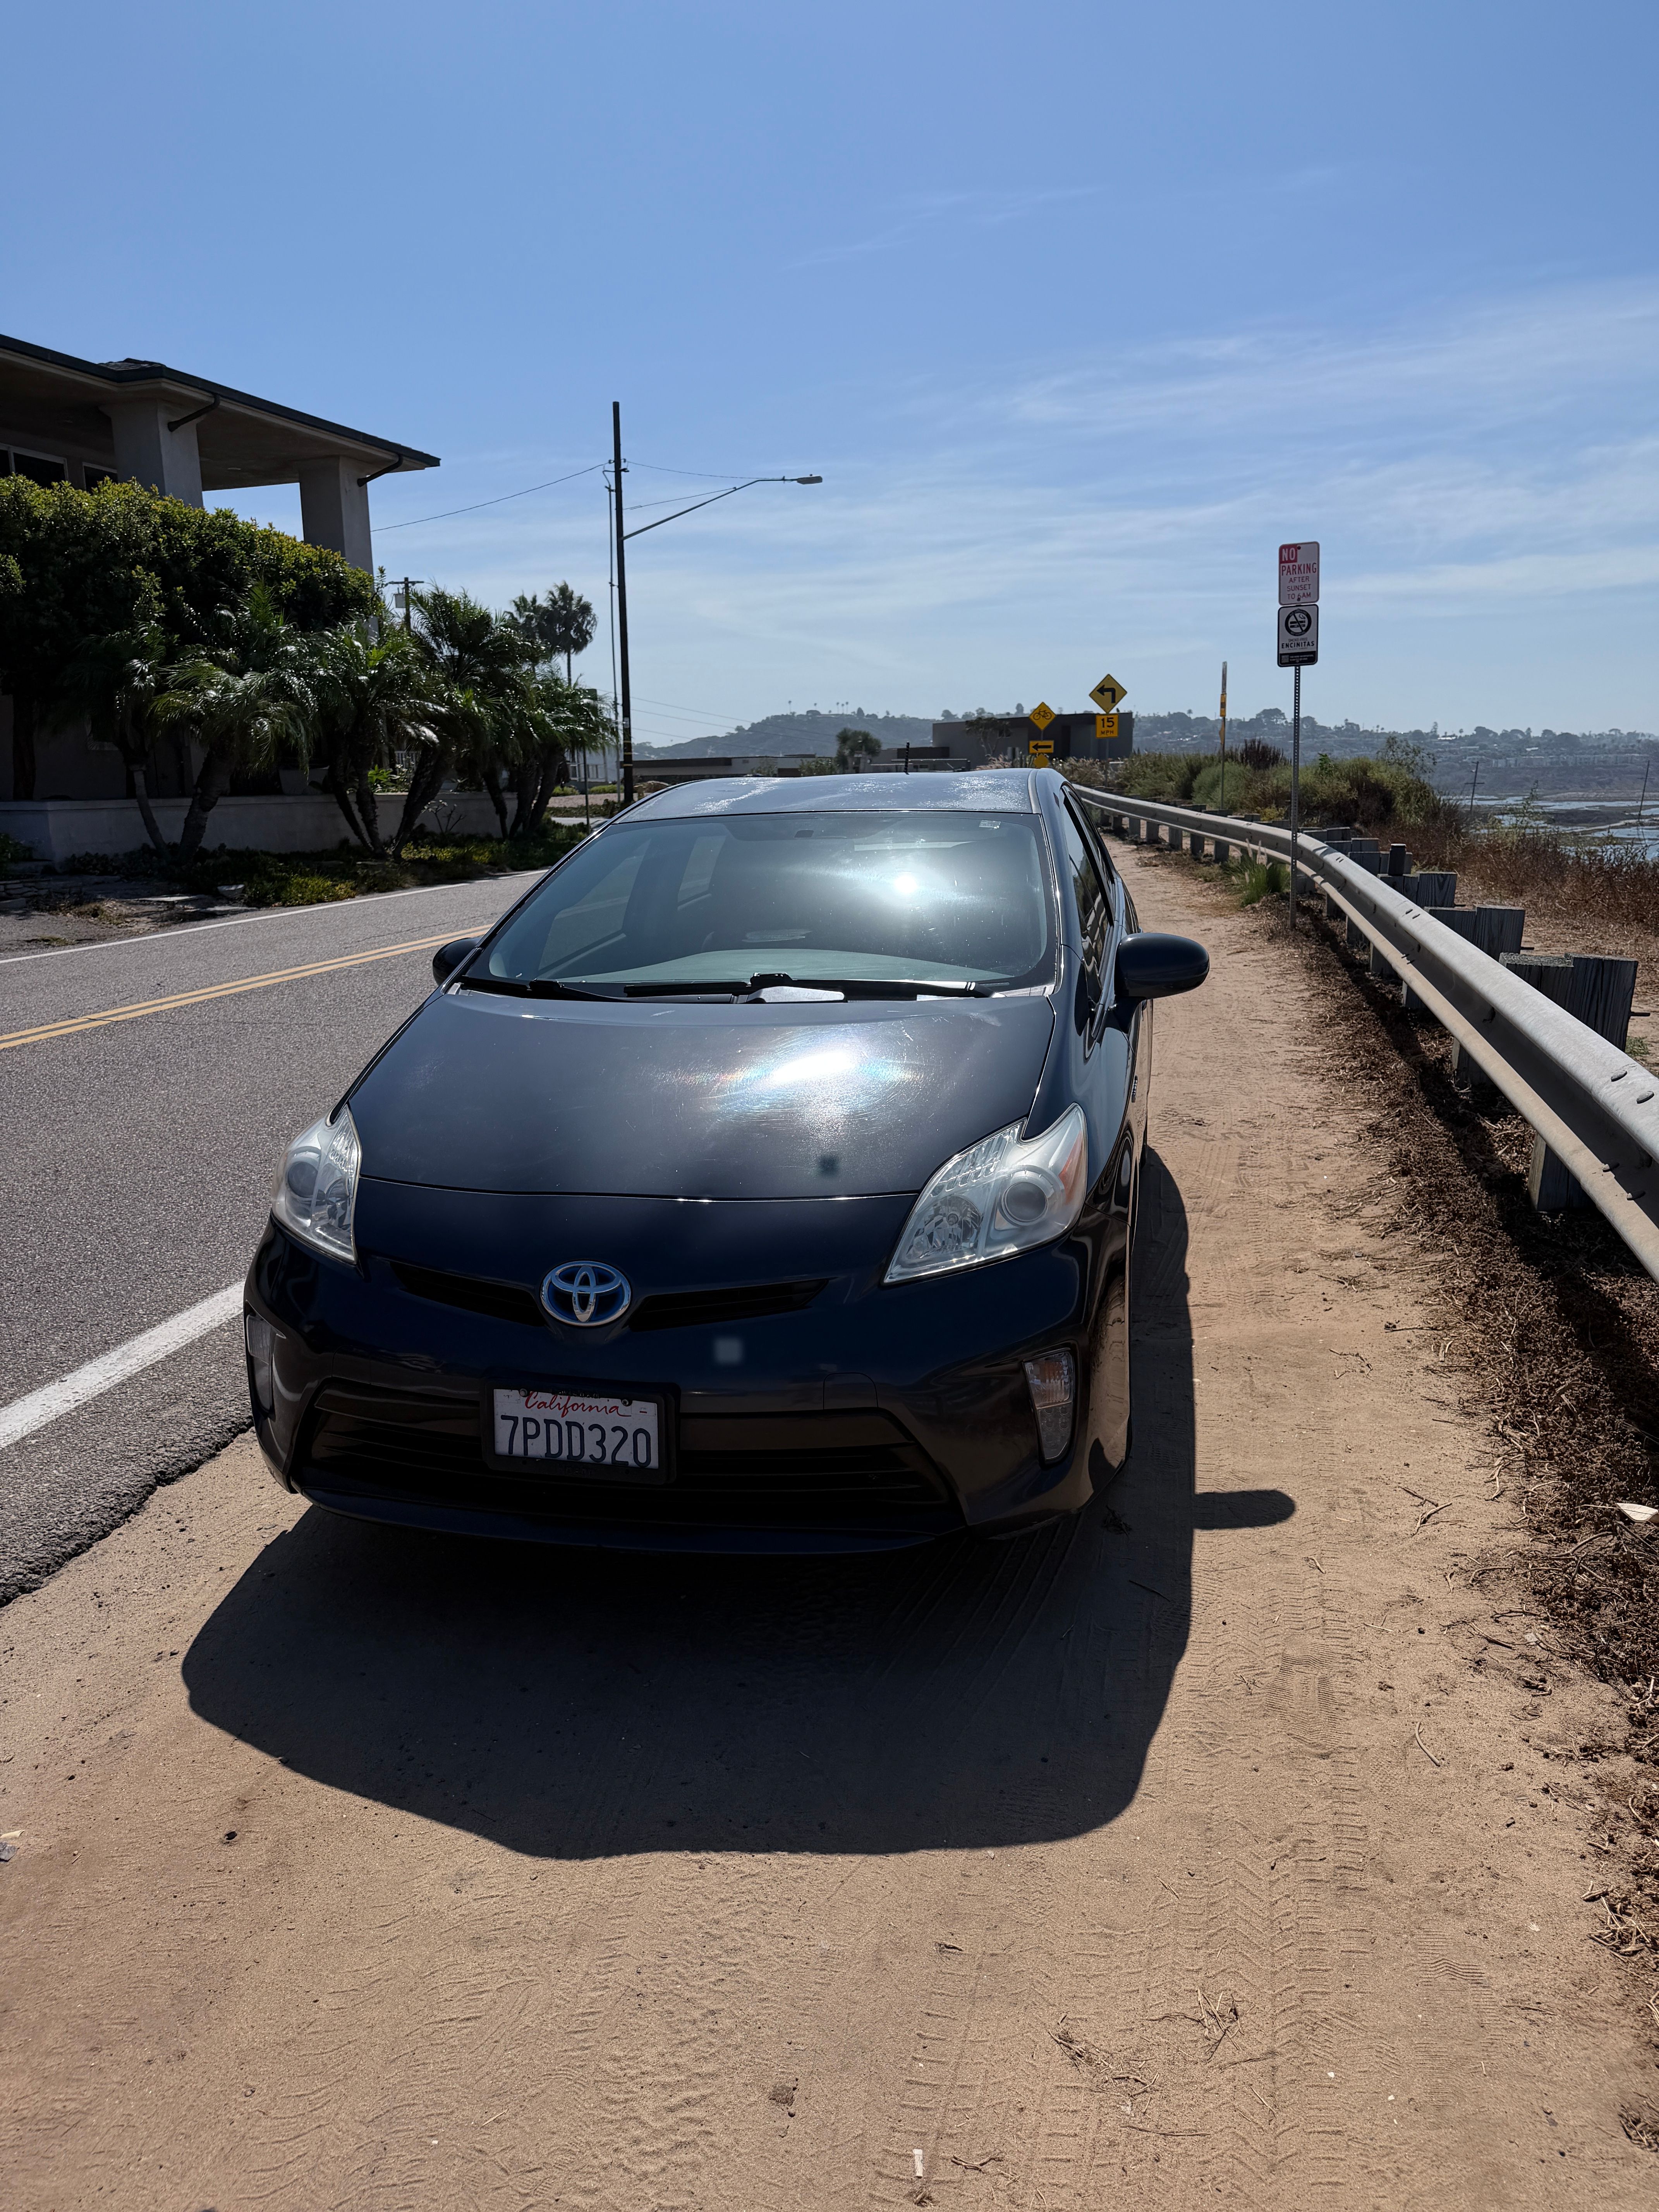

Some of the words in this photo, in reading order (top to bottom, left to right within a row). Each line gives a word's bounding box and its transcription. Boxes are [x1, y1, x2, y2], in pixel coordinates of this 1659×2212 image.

[1282, 548, 1295, 561] NO
[1281, 563, 1317, 576] PARKING
[1101, 717, 1115, 728] 15
[525, 1391, 632, 1418] California
[501, 1415, 651, 1468] 7PDD320
